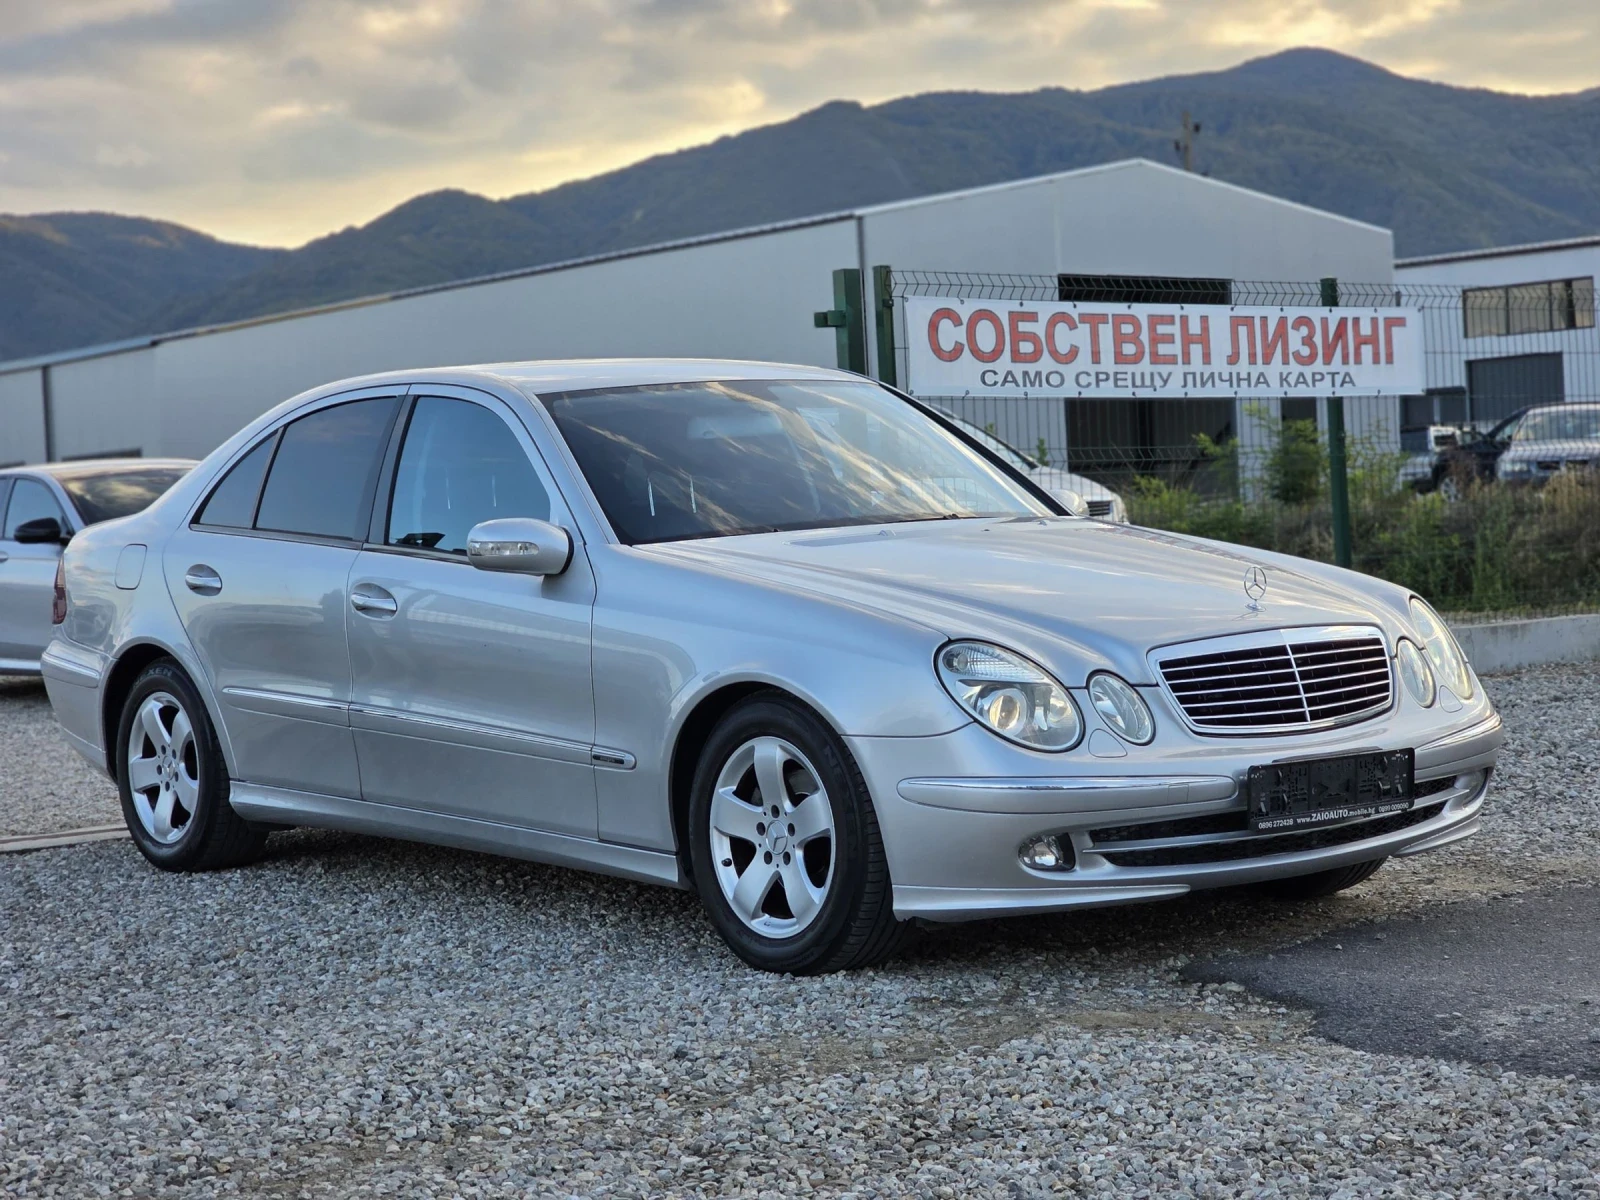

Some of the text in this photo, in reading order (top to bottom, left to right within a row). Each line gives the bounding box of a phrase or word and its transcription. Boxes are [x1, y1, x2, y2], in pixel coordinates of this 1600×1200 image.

[927, 307, 1407, 366] СОБСТВЕН ЛИЗИНГ
[980, 369, 1357, 391] САМО СРЕЩУ ЛИЧНА КАРТА
